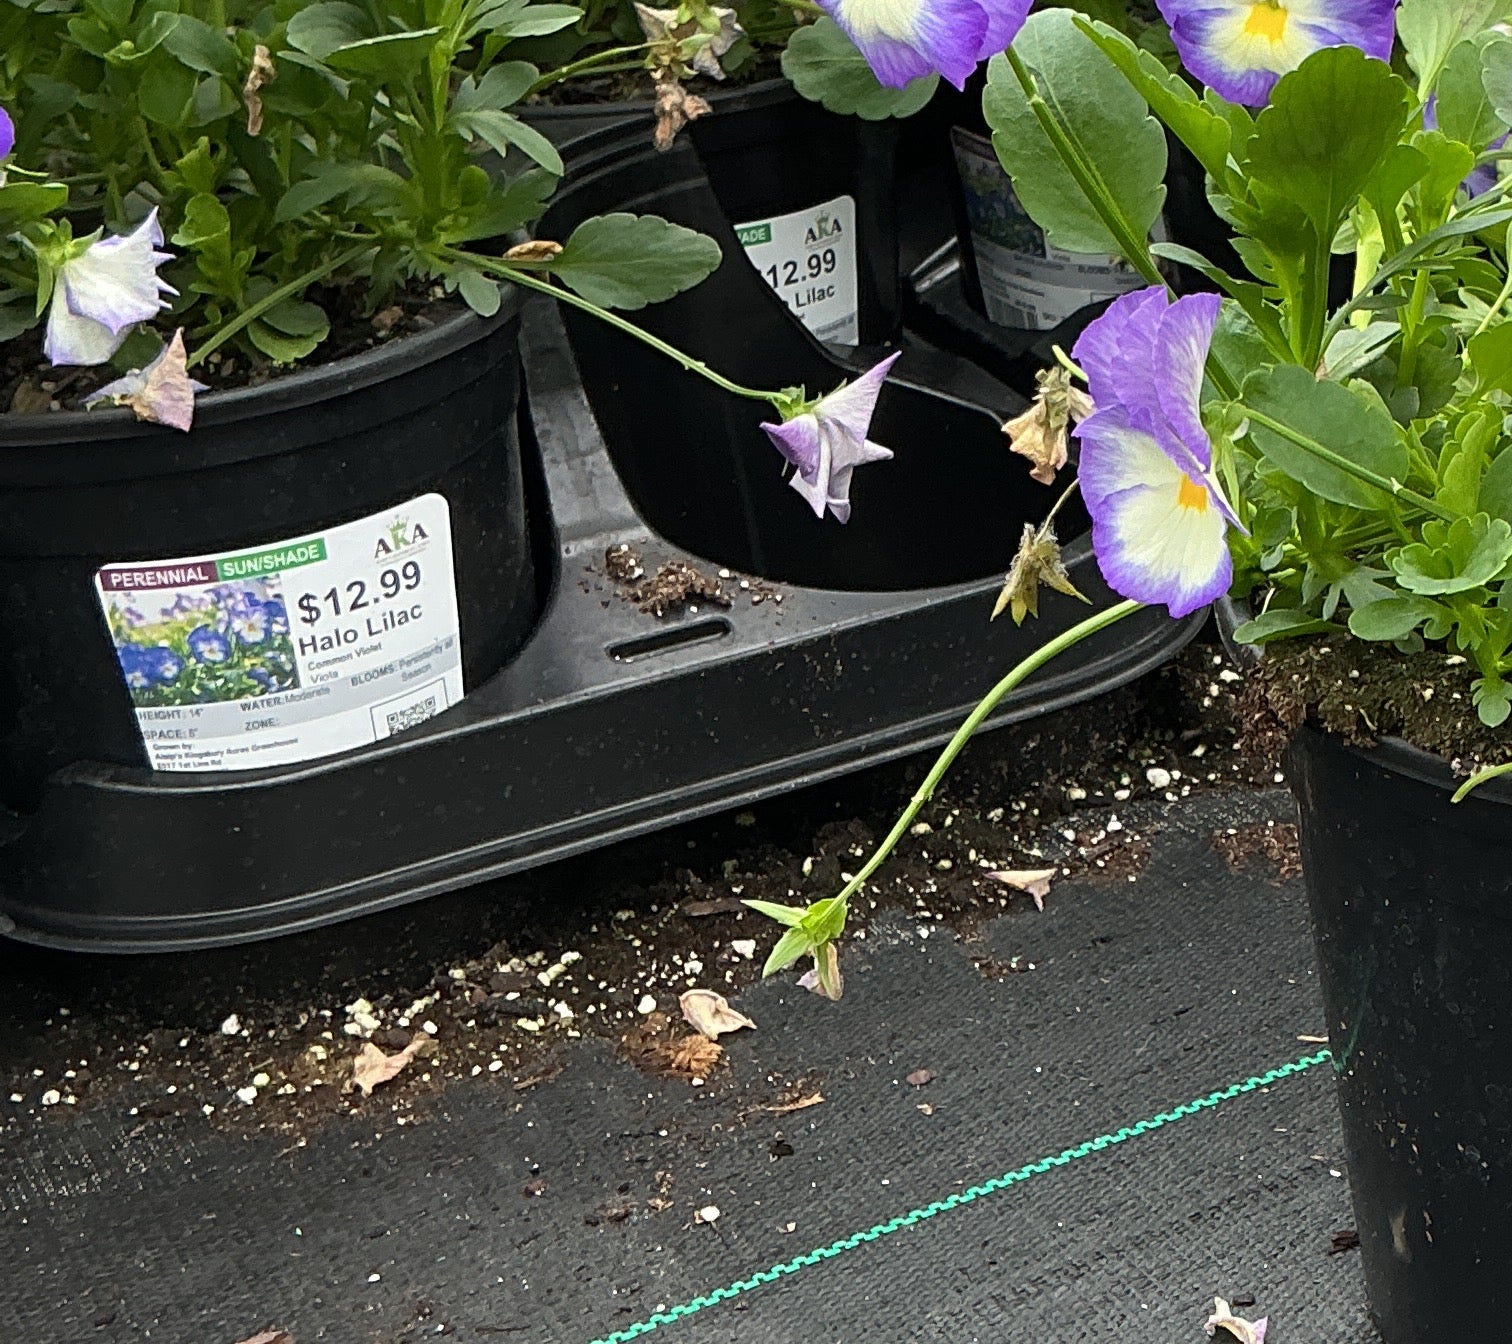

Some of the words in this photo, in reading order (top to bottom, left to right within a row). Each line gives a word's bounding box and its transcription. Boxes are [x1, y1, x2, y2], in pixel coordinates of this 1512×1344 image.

[765, 248, 836, 289] 12.99
[795, 284, 836, 308] Lilac
[374, 522, 429, 560] AKA
[110, 566, 210, 588] PERENNIAL
[222, 544, 321, 577] SUN/SHADE
[297, 560, 422, 627] $12.99
[298, 627, 358, 656] Halo
[366, 604, 423, 637] Lilac
[307, 652, 352, 671] Common
[354, 642, 383, 657] Violet
[310, 670, 339, 684] Viola
